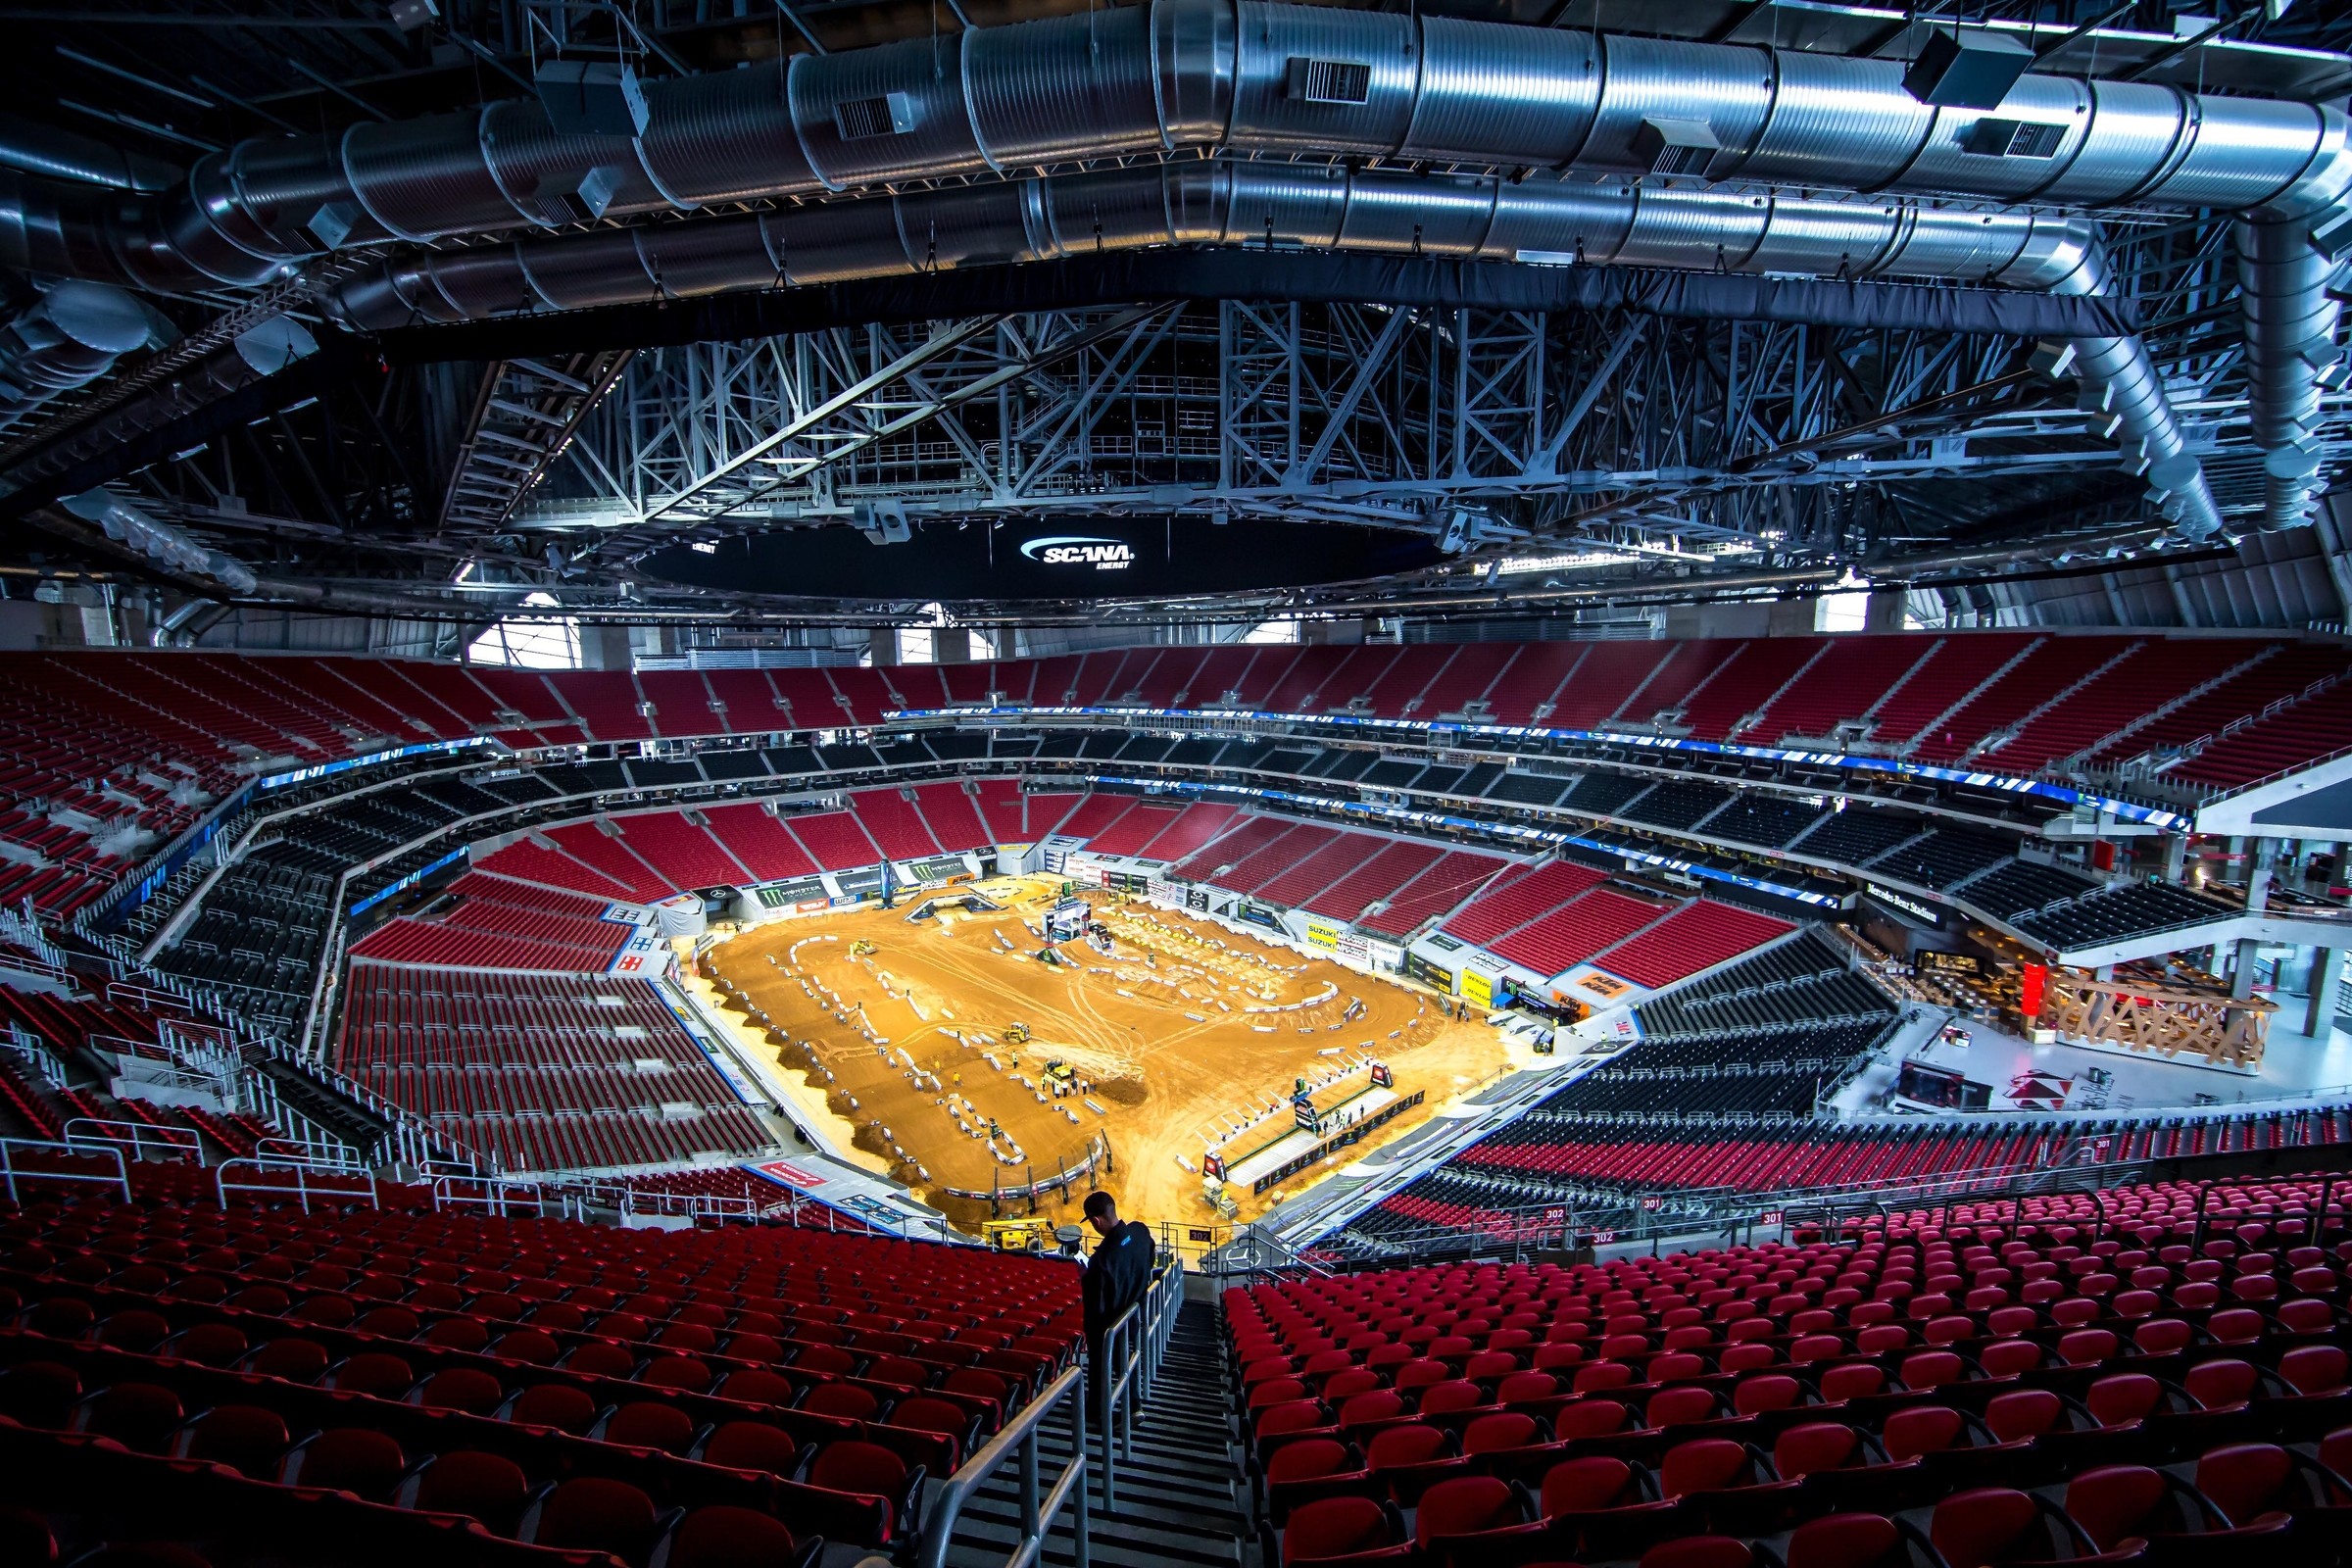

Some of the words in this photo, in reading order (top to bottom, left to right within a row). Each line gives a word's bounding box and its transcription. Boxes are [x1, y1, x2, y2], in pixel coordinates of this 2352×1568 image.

[1043, 545, 1130, 564] SCANA
[1096, 561, 1130, 570] ENERGY
[782, 886, 821, 896] MONSTER
[1866, 883, 1911, 910] Mercedes-Benz
[1910, 903, 1936, 922] Stadium
[1308, 925, 1337, 938] SUZUKI
[1307, 936, 1336, 950] SUZUKI
[1467, 975, 1492, 988] DUNLOP
[1466, 988, 1491, 1001] DUNLOP
[1643, 1200, 1660, 1208] 301
[1546, 1209, 1564, 1218] 302
[1764, 1213, 1782, 1223] 301
[1191, 1231, 1208, 1241] 302
[1593, 1233, 1613, 1243] 302
